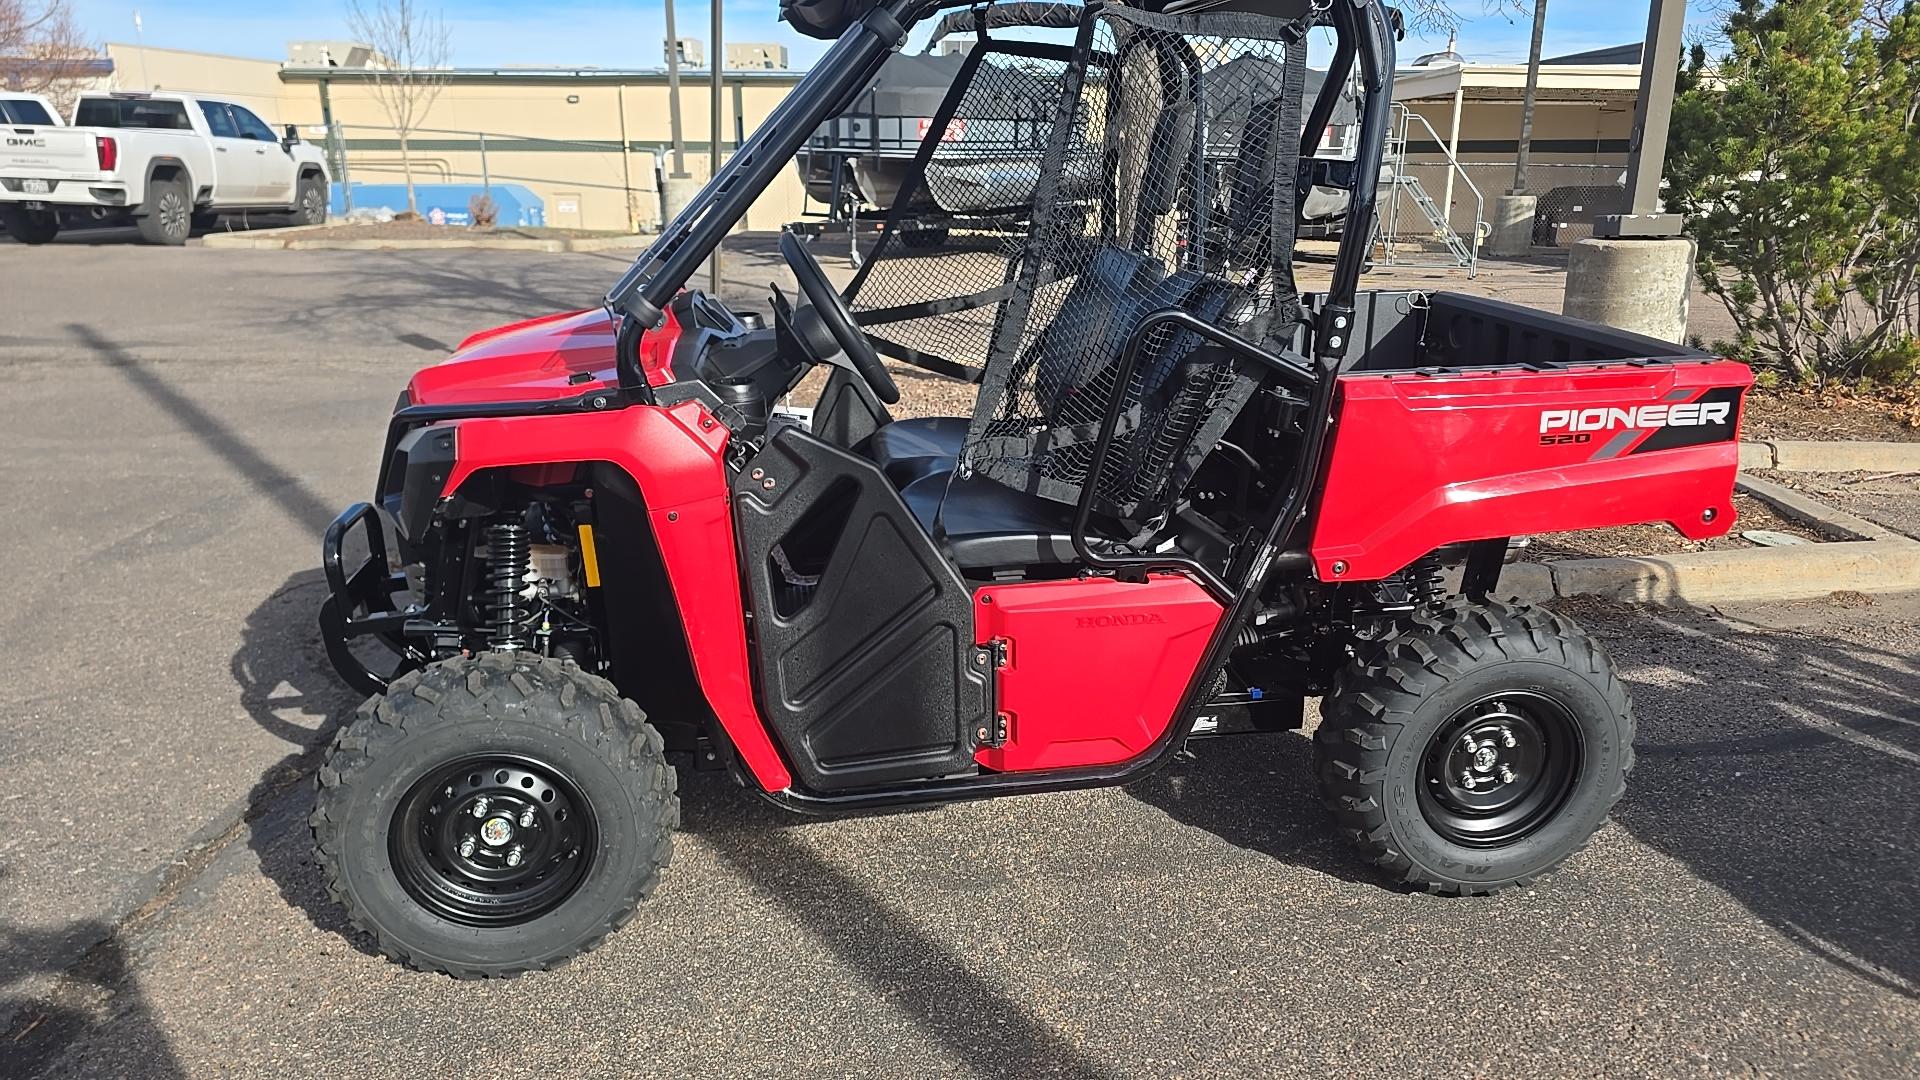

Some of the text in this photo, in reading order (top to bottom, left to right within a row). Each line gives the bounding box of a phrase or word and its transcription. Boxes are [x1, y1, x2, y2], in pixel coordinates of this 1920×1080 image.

[6, 138, 46, 147] GMC
[1539, 401, 1731, 434] PIONEER
[1539, 433, 1591, 446] 520
[1075, 612, 1169, 629] HONDA
